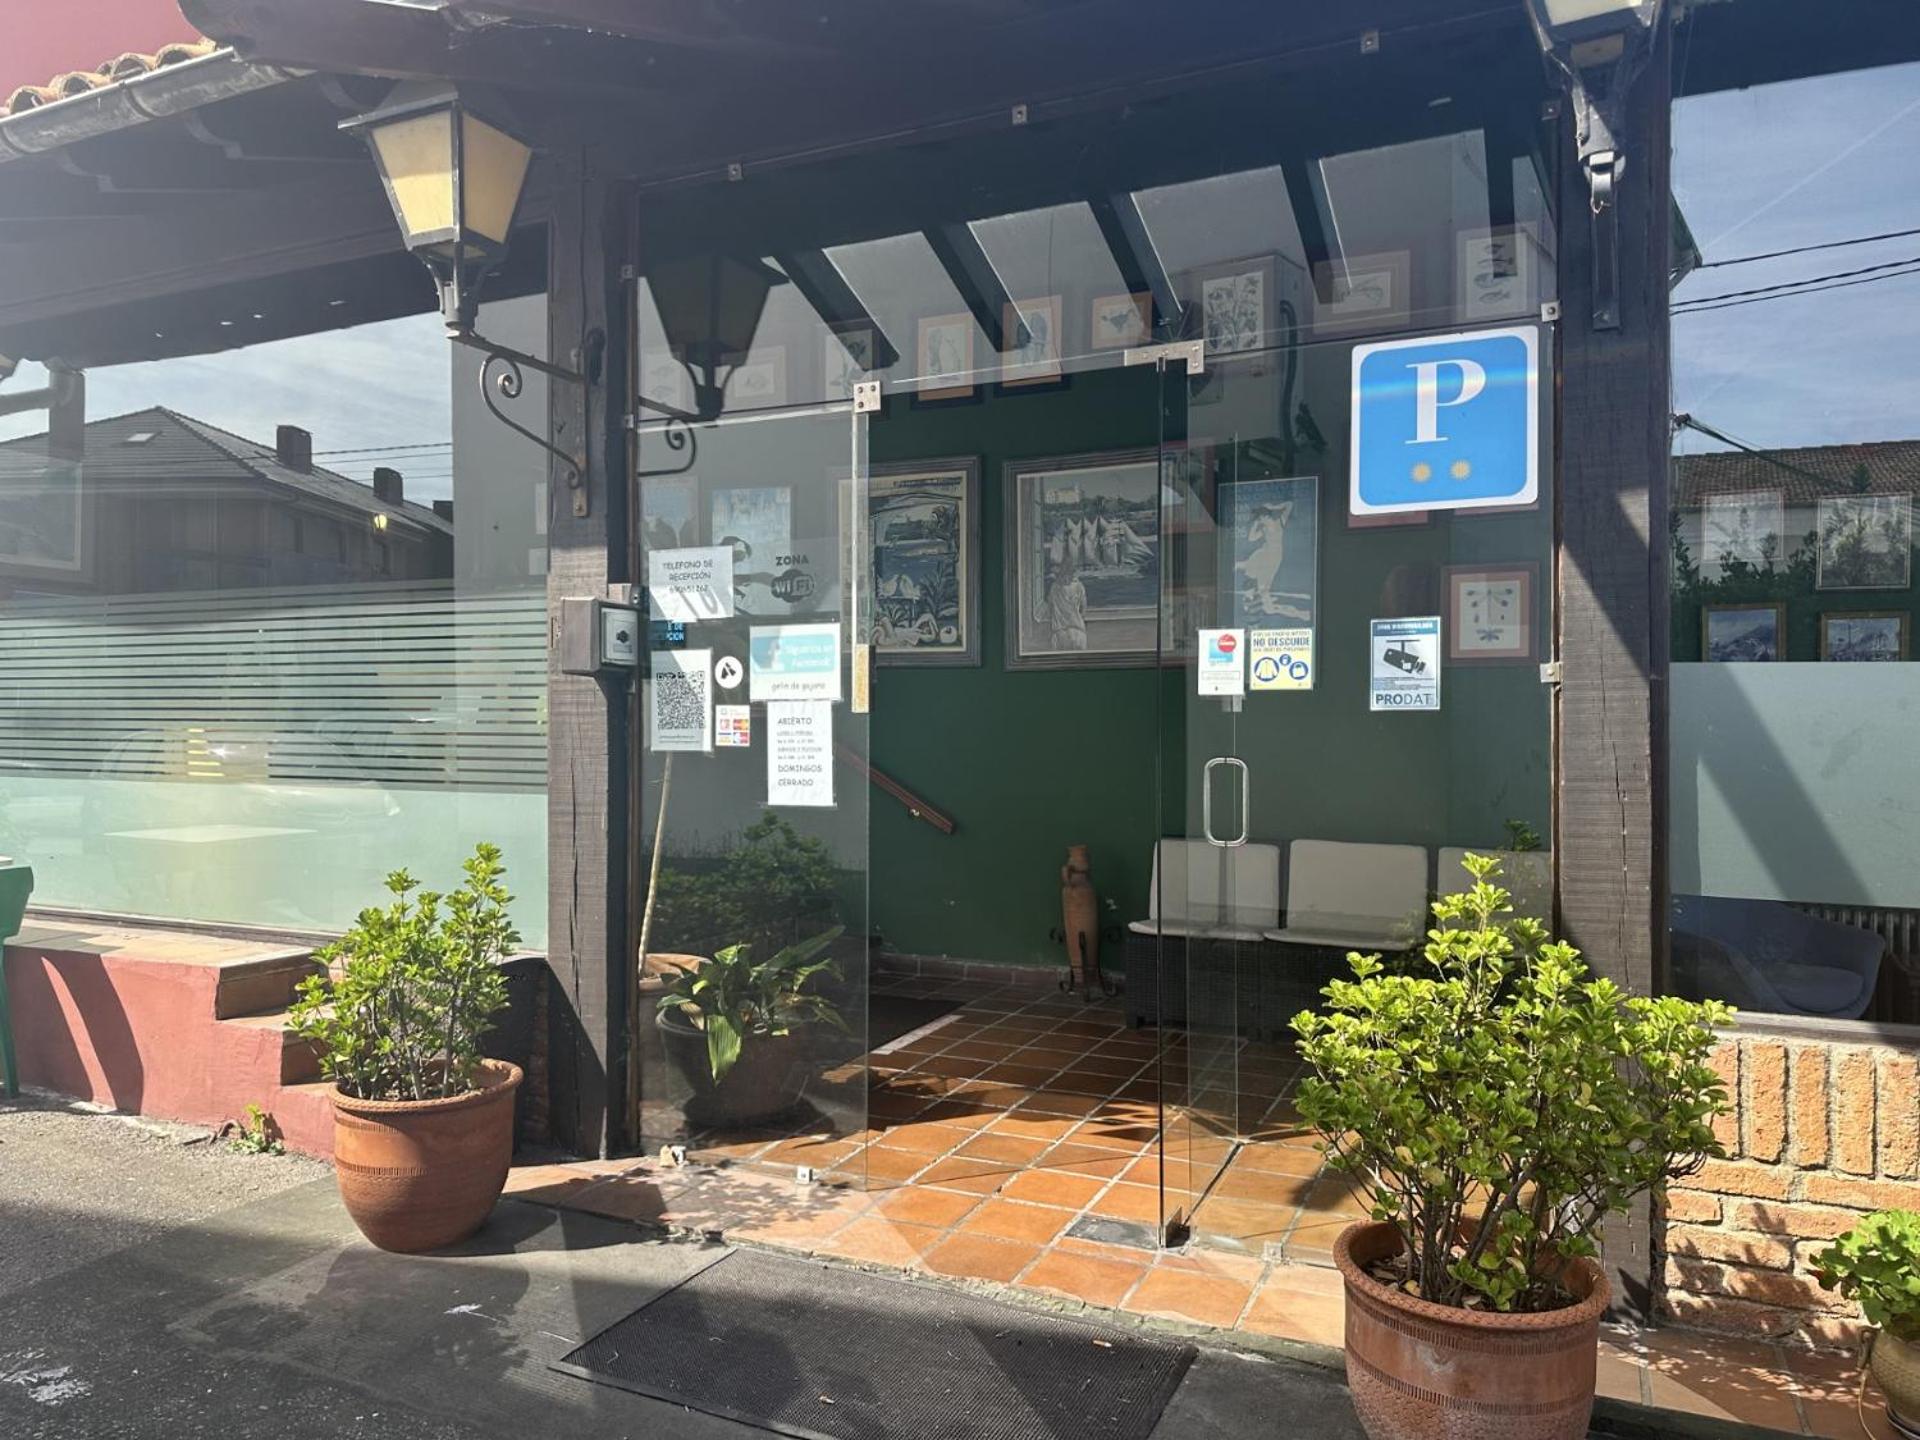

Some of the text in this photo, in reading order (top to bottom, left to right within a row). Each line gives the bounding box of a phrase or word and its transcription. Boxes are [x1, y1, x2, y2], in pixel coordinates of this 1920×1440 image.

[1405, 358, 1487, 444] P
[703, 559, 713, 568] DE
[775, 554, 809, 566] ZONA
[1253, 636, 1309, 647] NO DESCUIDE
[1375, 693, 1433, 705] PRODAT
[777, 716, 813, 726] ABIERTO
[777, 764, 823, 773] DOMINGOS
[777, 778, 814, 787] CERRADO
